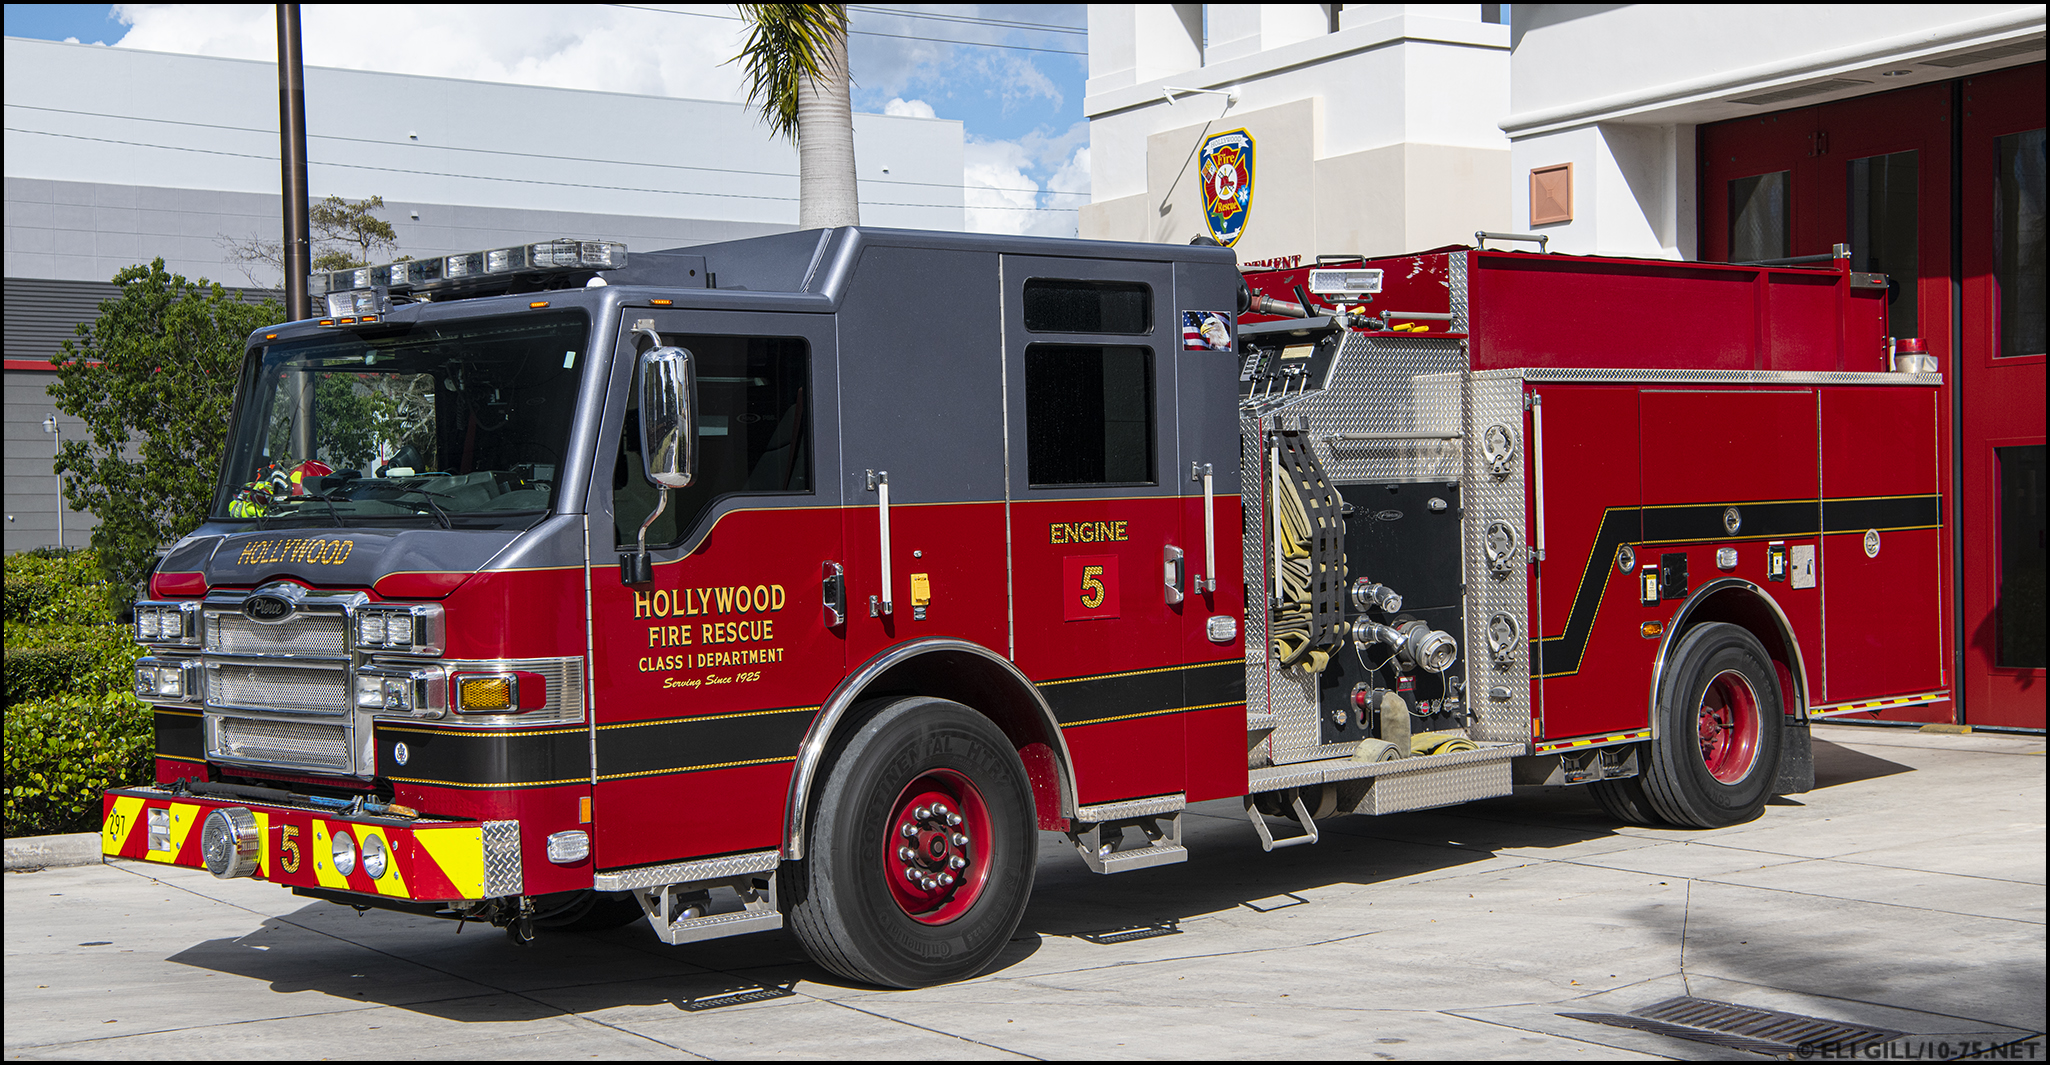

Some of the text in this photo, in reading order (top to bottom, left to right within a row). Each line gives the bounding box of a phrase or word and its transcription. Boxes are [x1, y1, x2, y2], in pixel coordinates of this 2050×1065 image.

[1217, 153, 1235, 165] Fire
[1217, 201, 1237, 212] Rescue
[1049, 520, 1129, 544] ENGINE
[236, 538, 354, 565] HOLLYWOOD
[1080, 565, 1105, 609] 5
[252, 598, 283, 616] Pierce
[632, 584, 786, 620] HOLLYWOOD
[648, 619, 774, 649] FIRE RESCUE
[638, 654, 684, 673] CLASS
[697, 647, 785, 669] DEPARTMENT
[662, 670, 761, 690] Serving Since 1925
[109, 813, 126, 836] 297
[279, 824, 301, 874] 5
[886, 921, 953, 960] Continental
